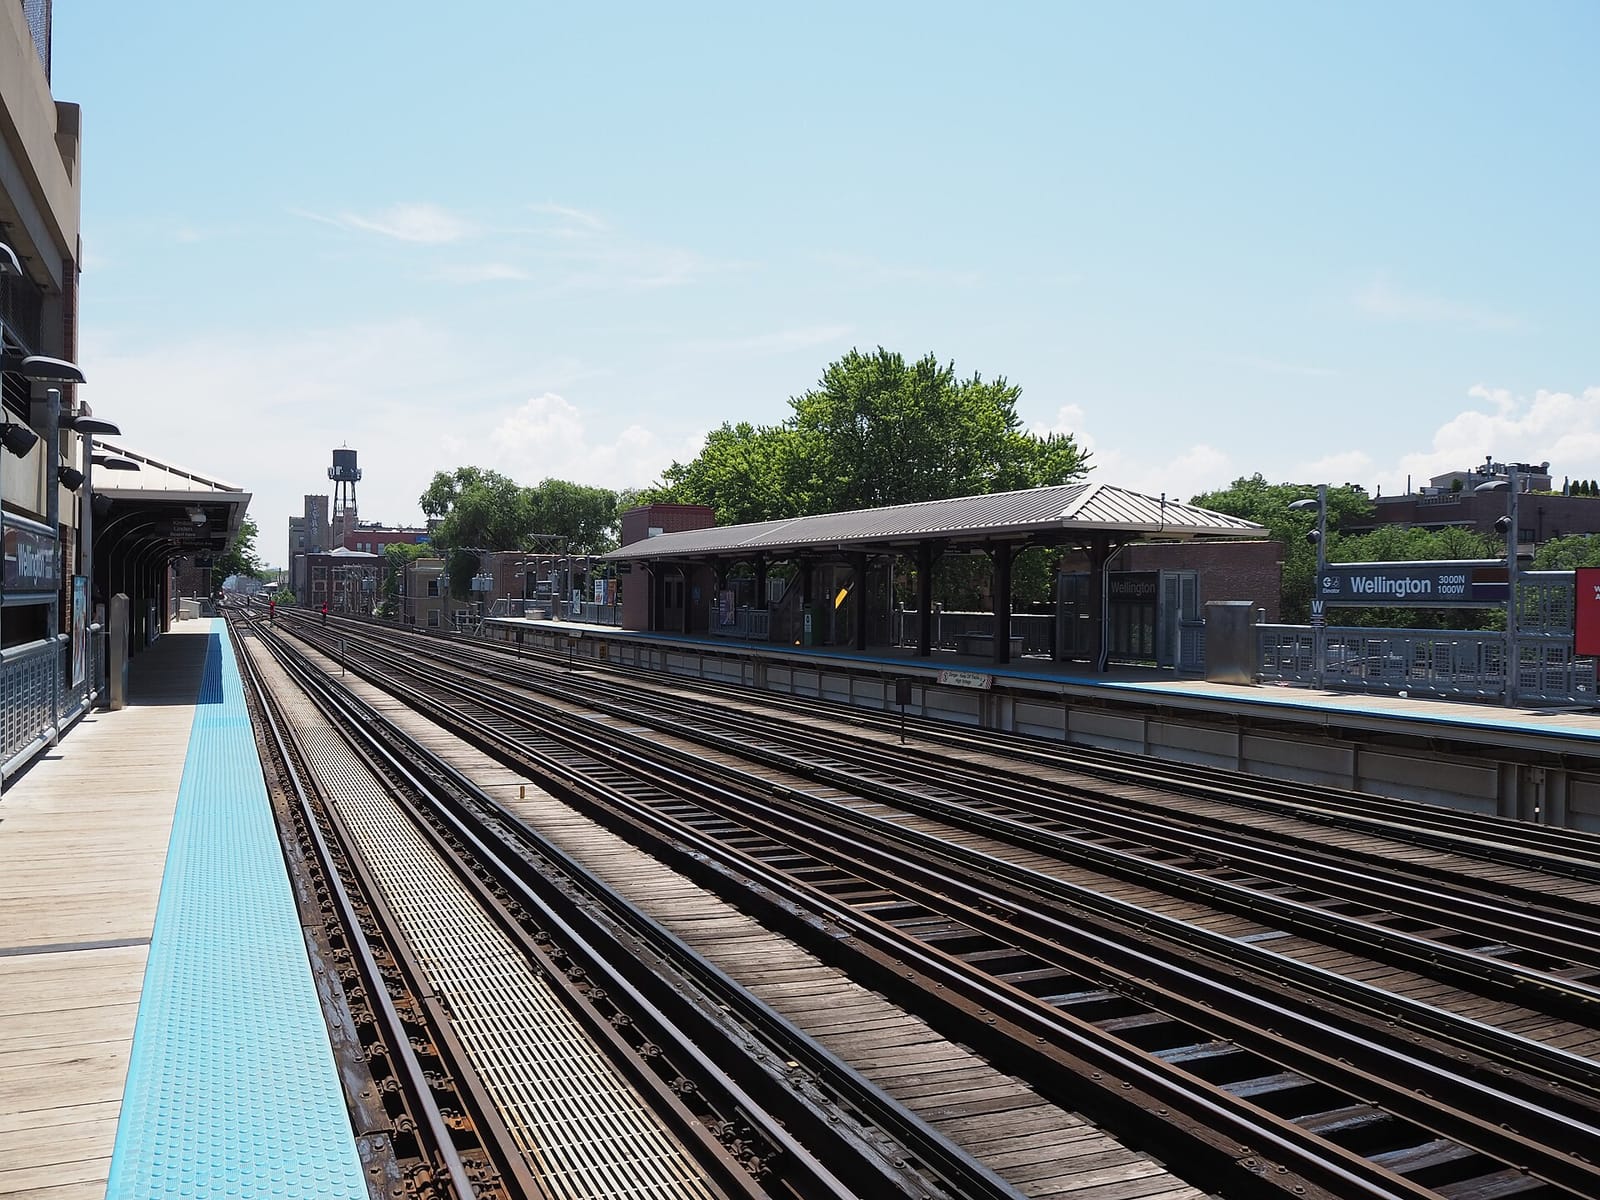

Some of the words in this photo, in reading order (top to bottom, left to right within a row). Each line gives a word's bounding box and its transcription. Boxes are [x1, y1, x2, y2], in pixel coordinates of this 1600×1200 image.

[1438, 575, 1465, 584] 3000N
[1111, 581, 1155, 596] Wellington
[1350, 576, 1431, 597] Wellington
[1437, 585, 1465, 594] 1000W
[1311, 600, 1323, 613] W
